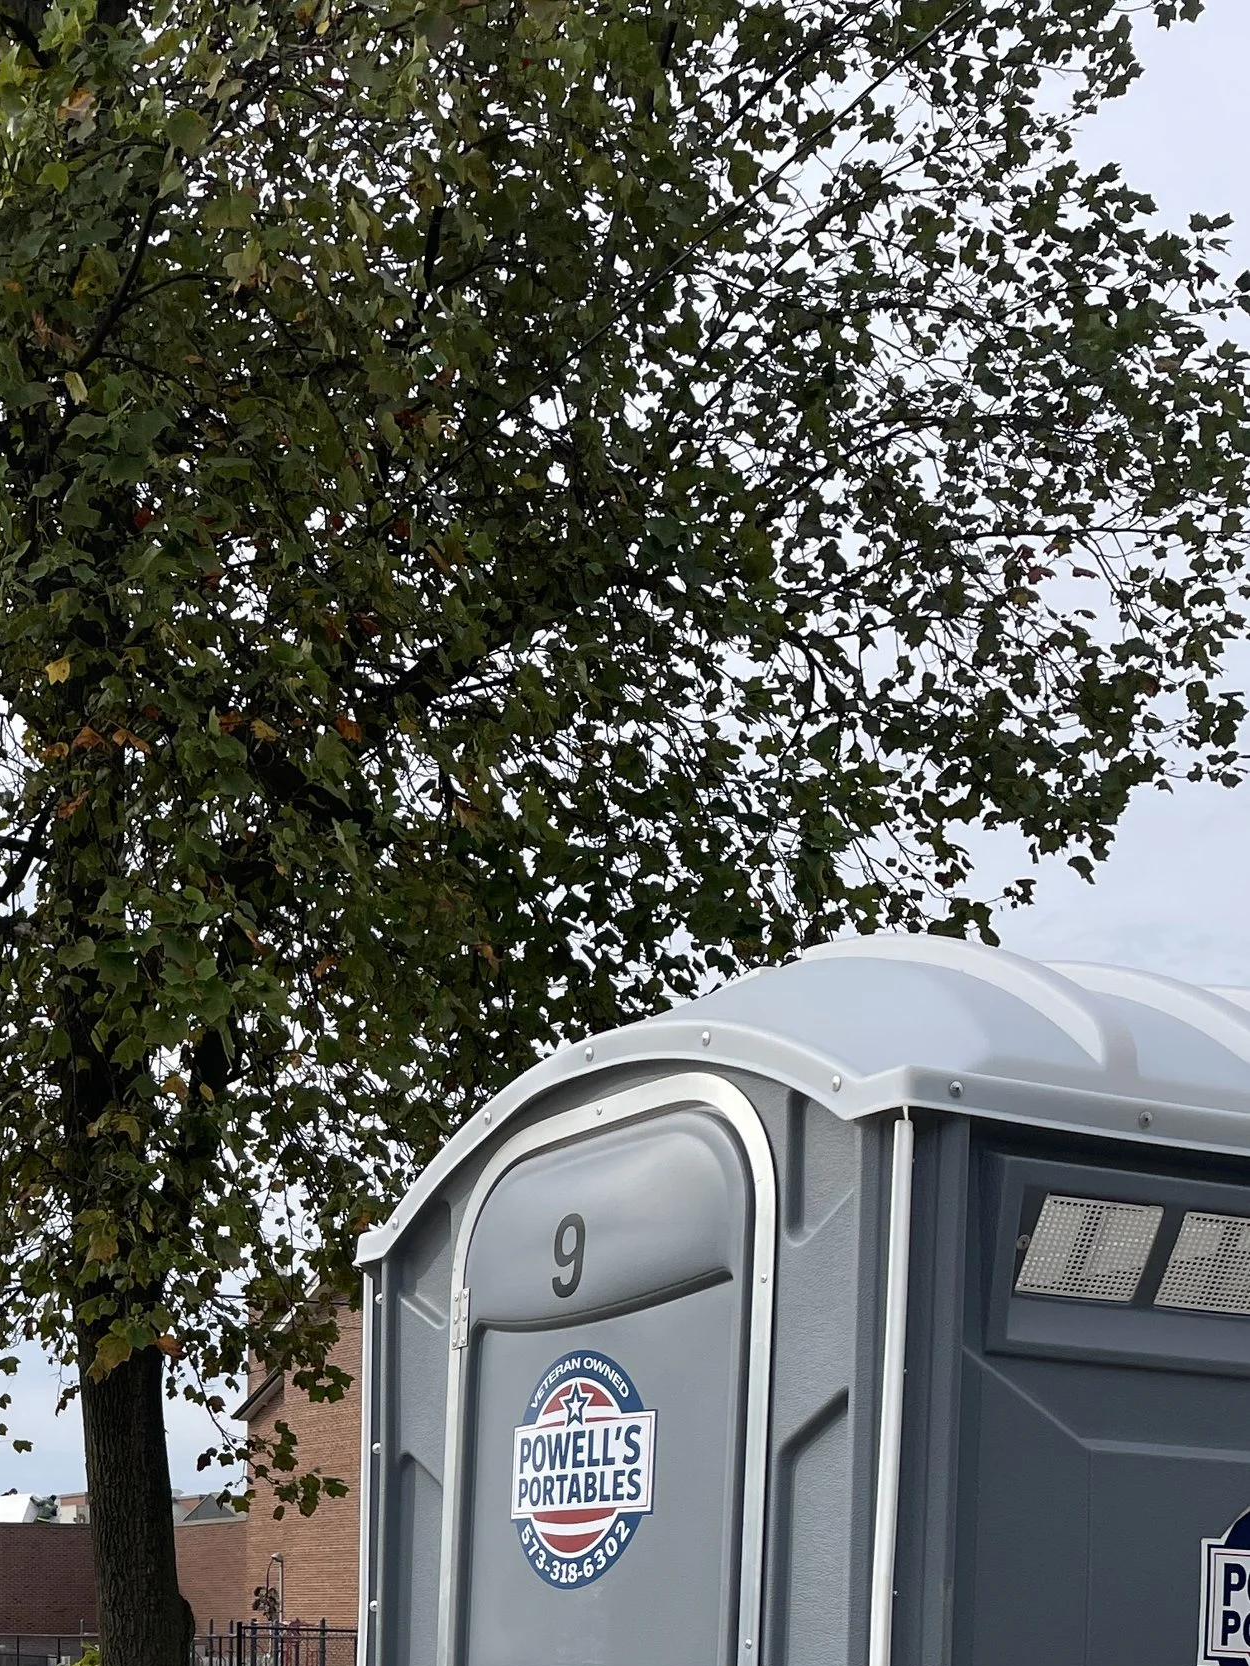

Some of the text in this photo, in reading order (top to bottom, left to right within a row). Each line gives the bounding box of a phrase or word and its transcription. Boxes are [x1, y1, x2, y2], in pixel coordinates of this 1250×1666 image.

[552, 1213, 586, 1298] 9
[530, 1357, 630, 1409] VETERAN OWNED
[519, 1424, 643, 1474] POWELL'S
[518, 1468, 642, 1508] PORTABLES
[521, 1520, 631, 1584] 573-318-6302
